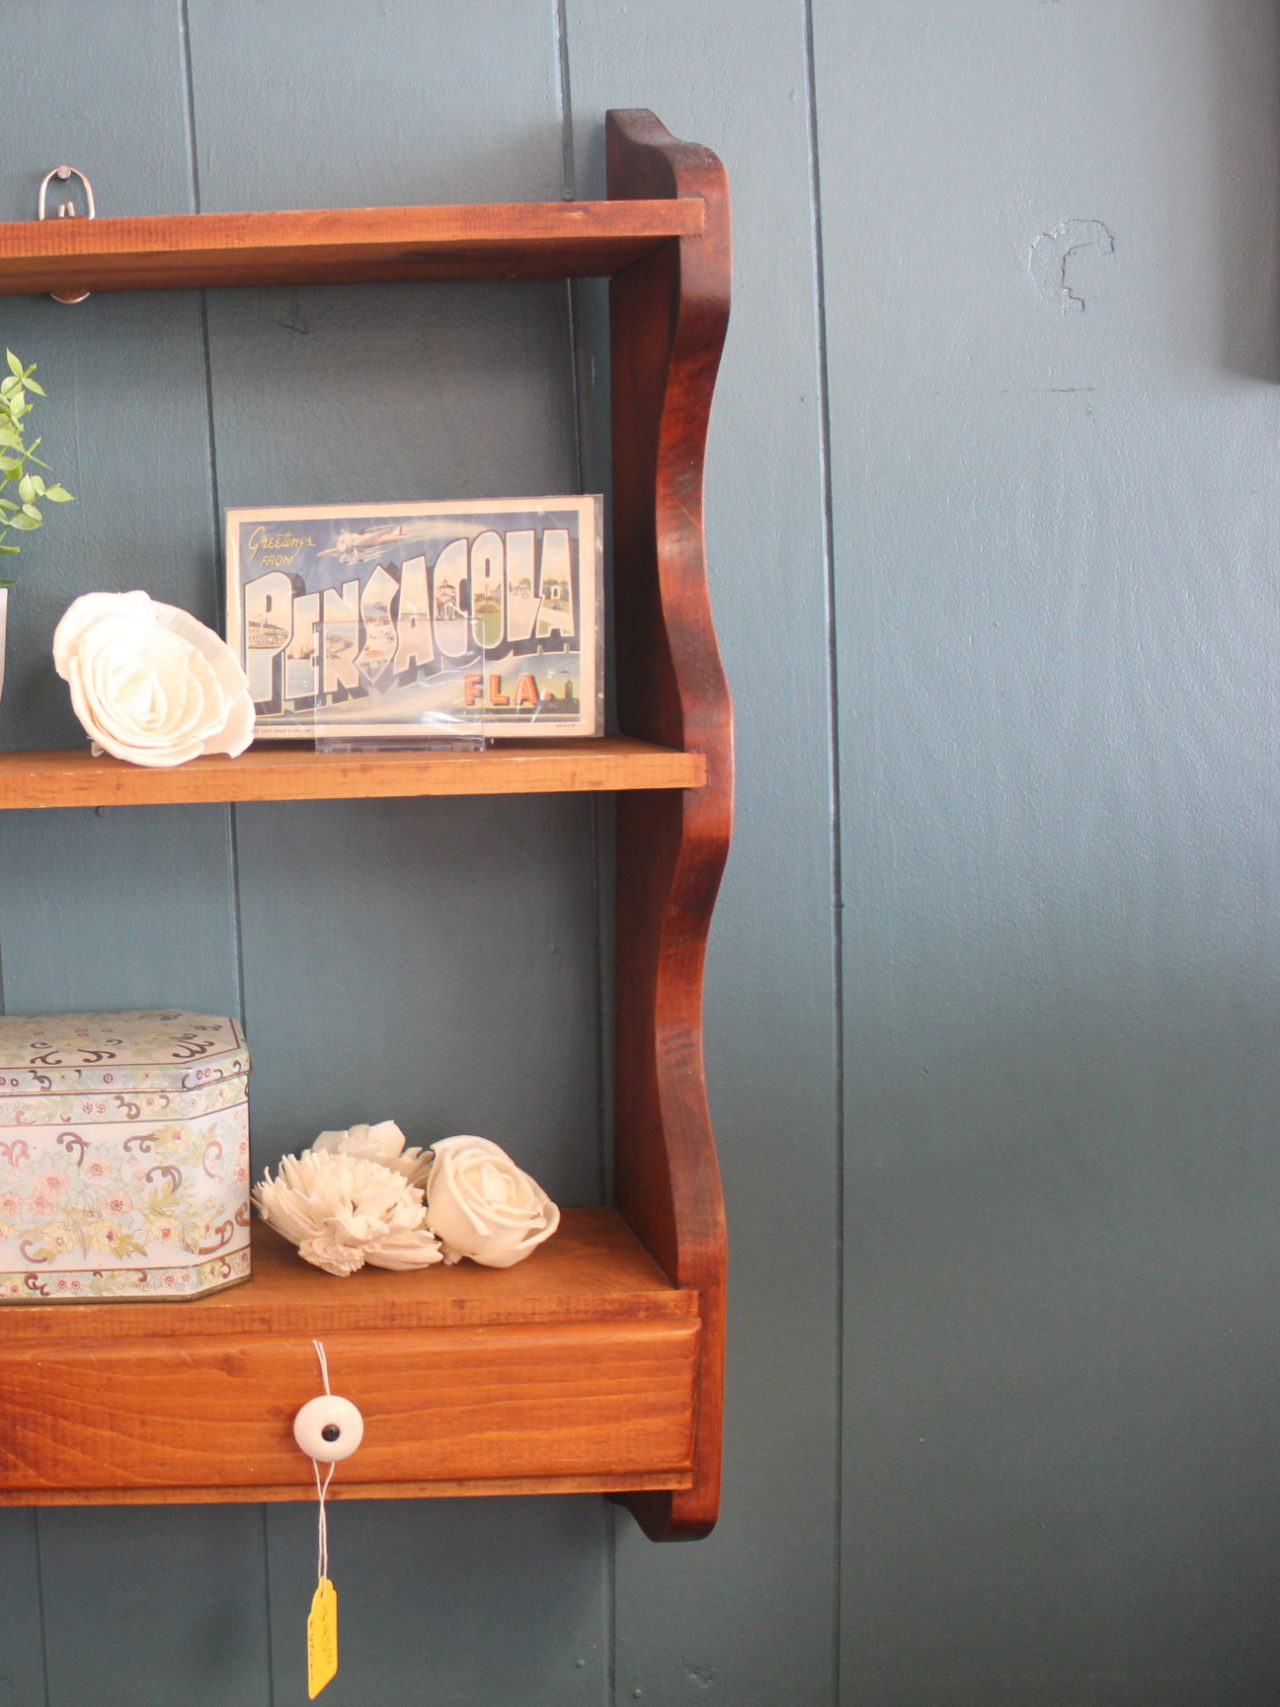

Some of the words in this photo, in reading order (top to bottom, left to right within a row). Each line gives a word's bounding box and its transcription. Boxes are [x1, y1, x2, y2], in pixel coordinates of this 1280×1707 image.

[260, 554, 295, 567] FROM
[245, 528, 575, 708] PENSACOLA
[464, 673, 554, 706] FLA.
